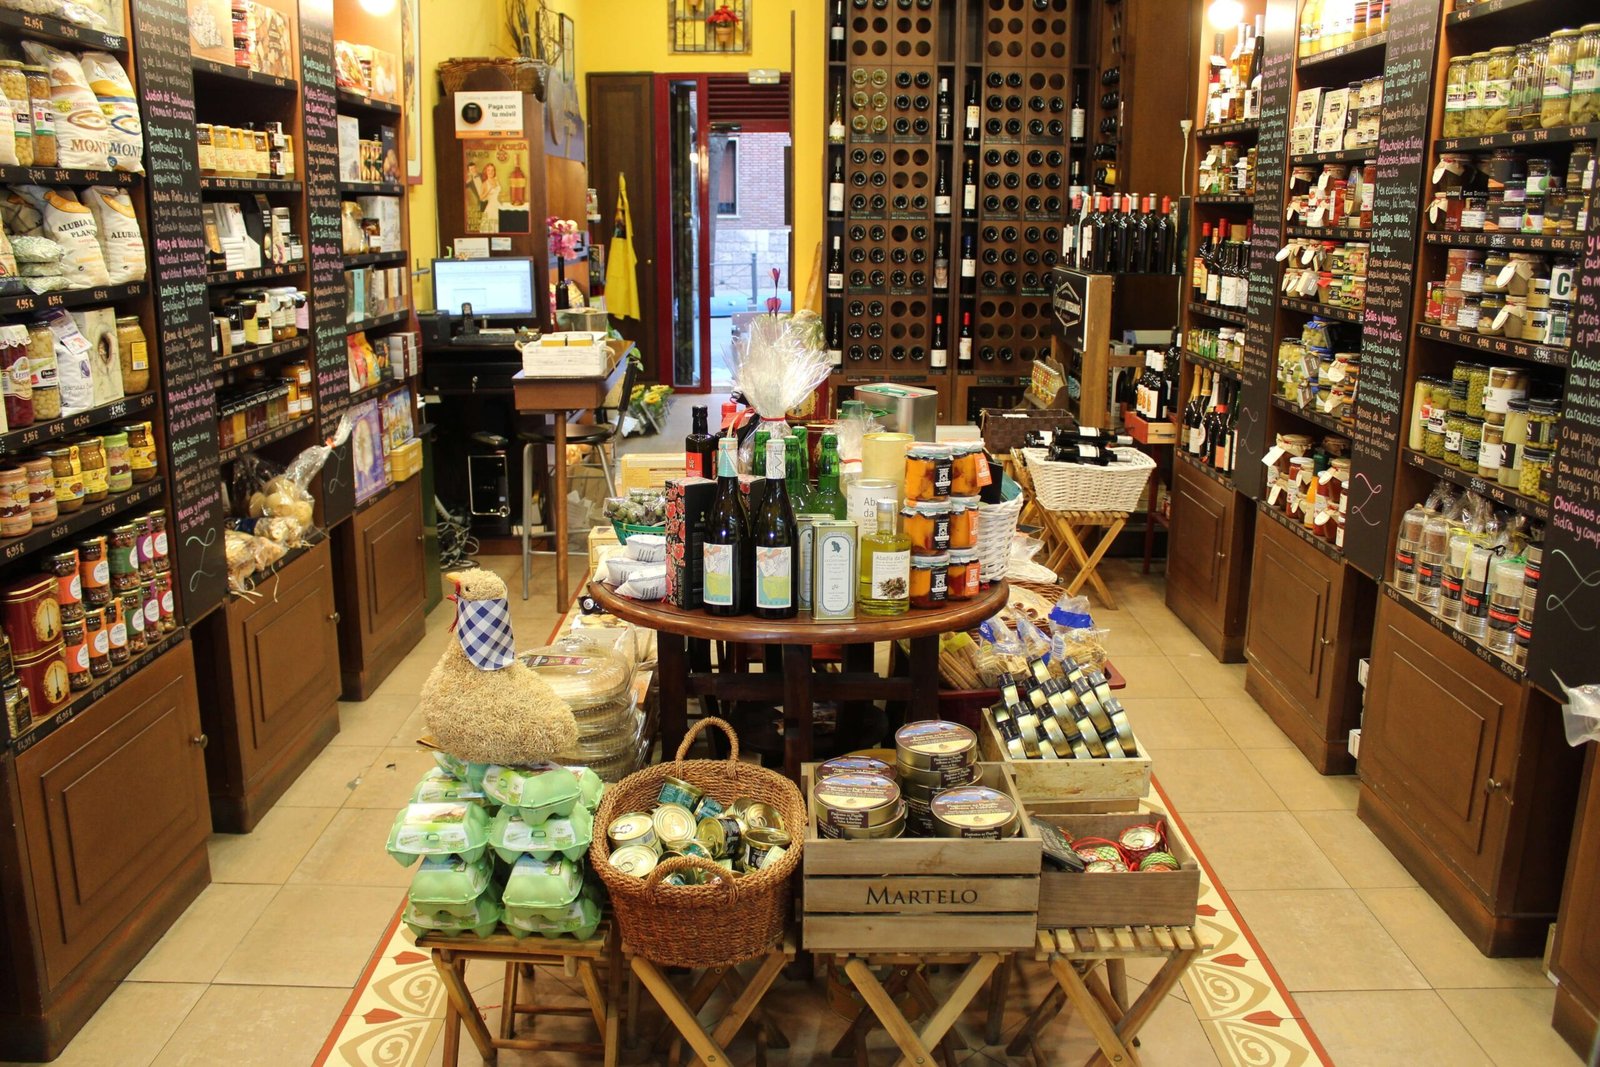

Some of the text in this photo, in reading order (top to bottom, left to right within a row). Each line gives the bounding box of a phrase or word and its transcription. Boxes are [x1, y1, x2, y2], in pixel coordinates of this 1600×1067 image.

[488, 103, 504, 111] Paga
[58, 219, 88, 233] ALUBIA
[111, 231, 135, 240] ALUBIA
[1586, 235, 1595, 256] y
[1582, 275, 1592, 287] en
[1578, 310, 1600, 326] otros
[1577, 329, 1585, 343] el
[1569, 374, 1588, 387] como
[1562, 426, 1569, 439] O
[1570, 430, 1580, 441] un
[1560, 444, 1595, 465] de tortilla
[1557, 475, 1590, 503] Burgos y
[863, 508, 874, 517] da
[1553, 514, 1574, 532] Sidra
[1573, 525, 1582, 542] y
[866, 885, 978, 905] MARTELO
